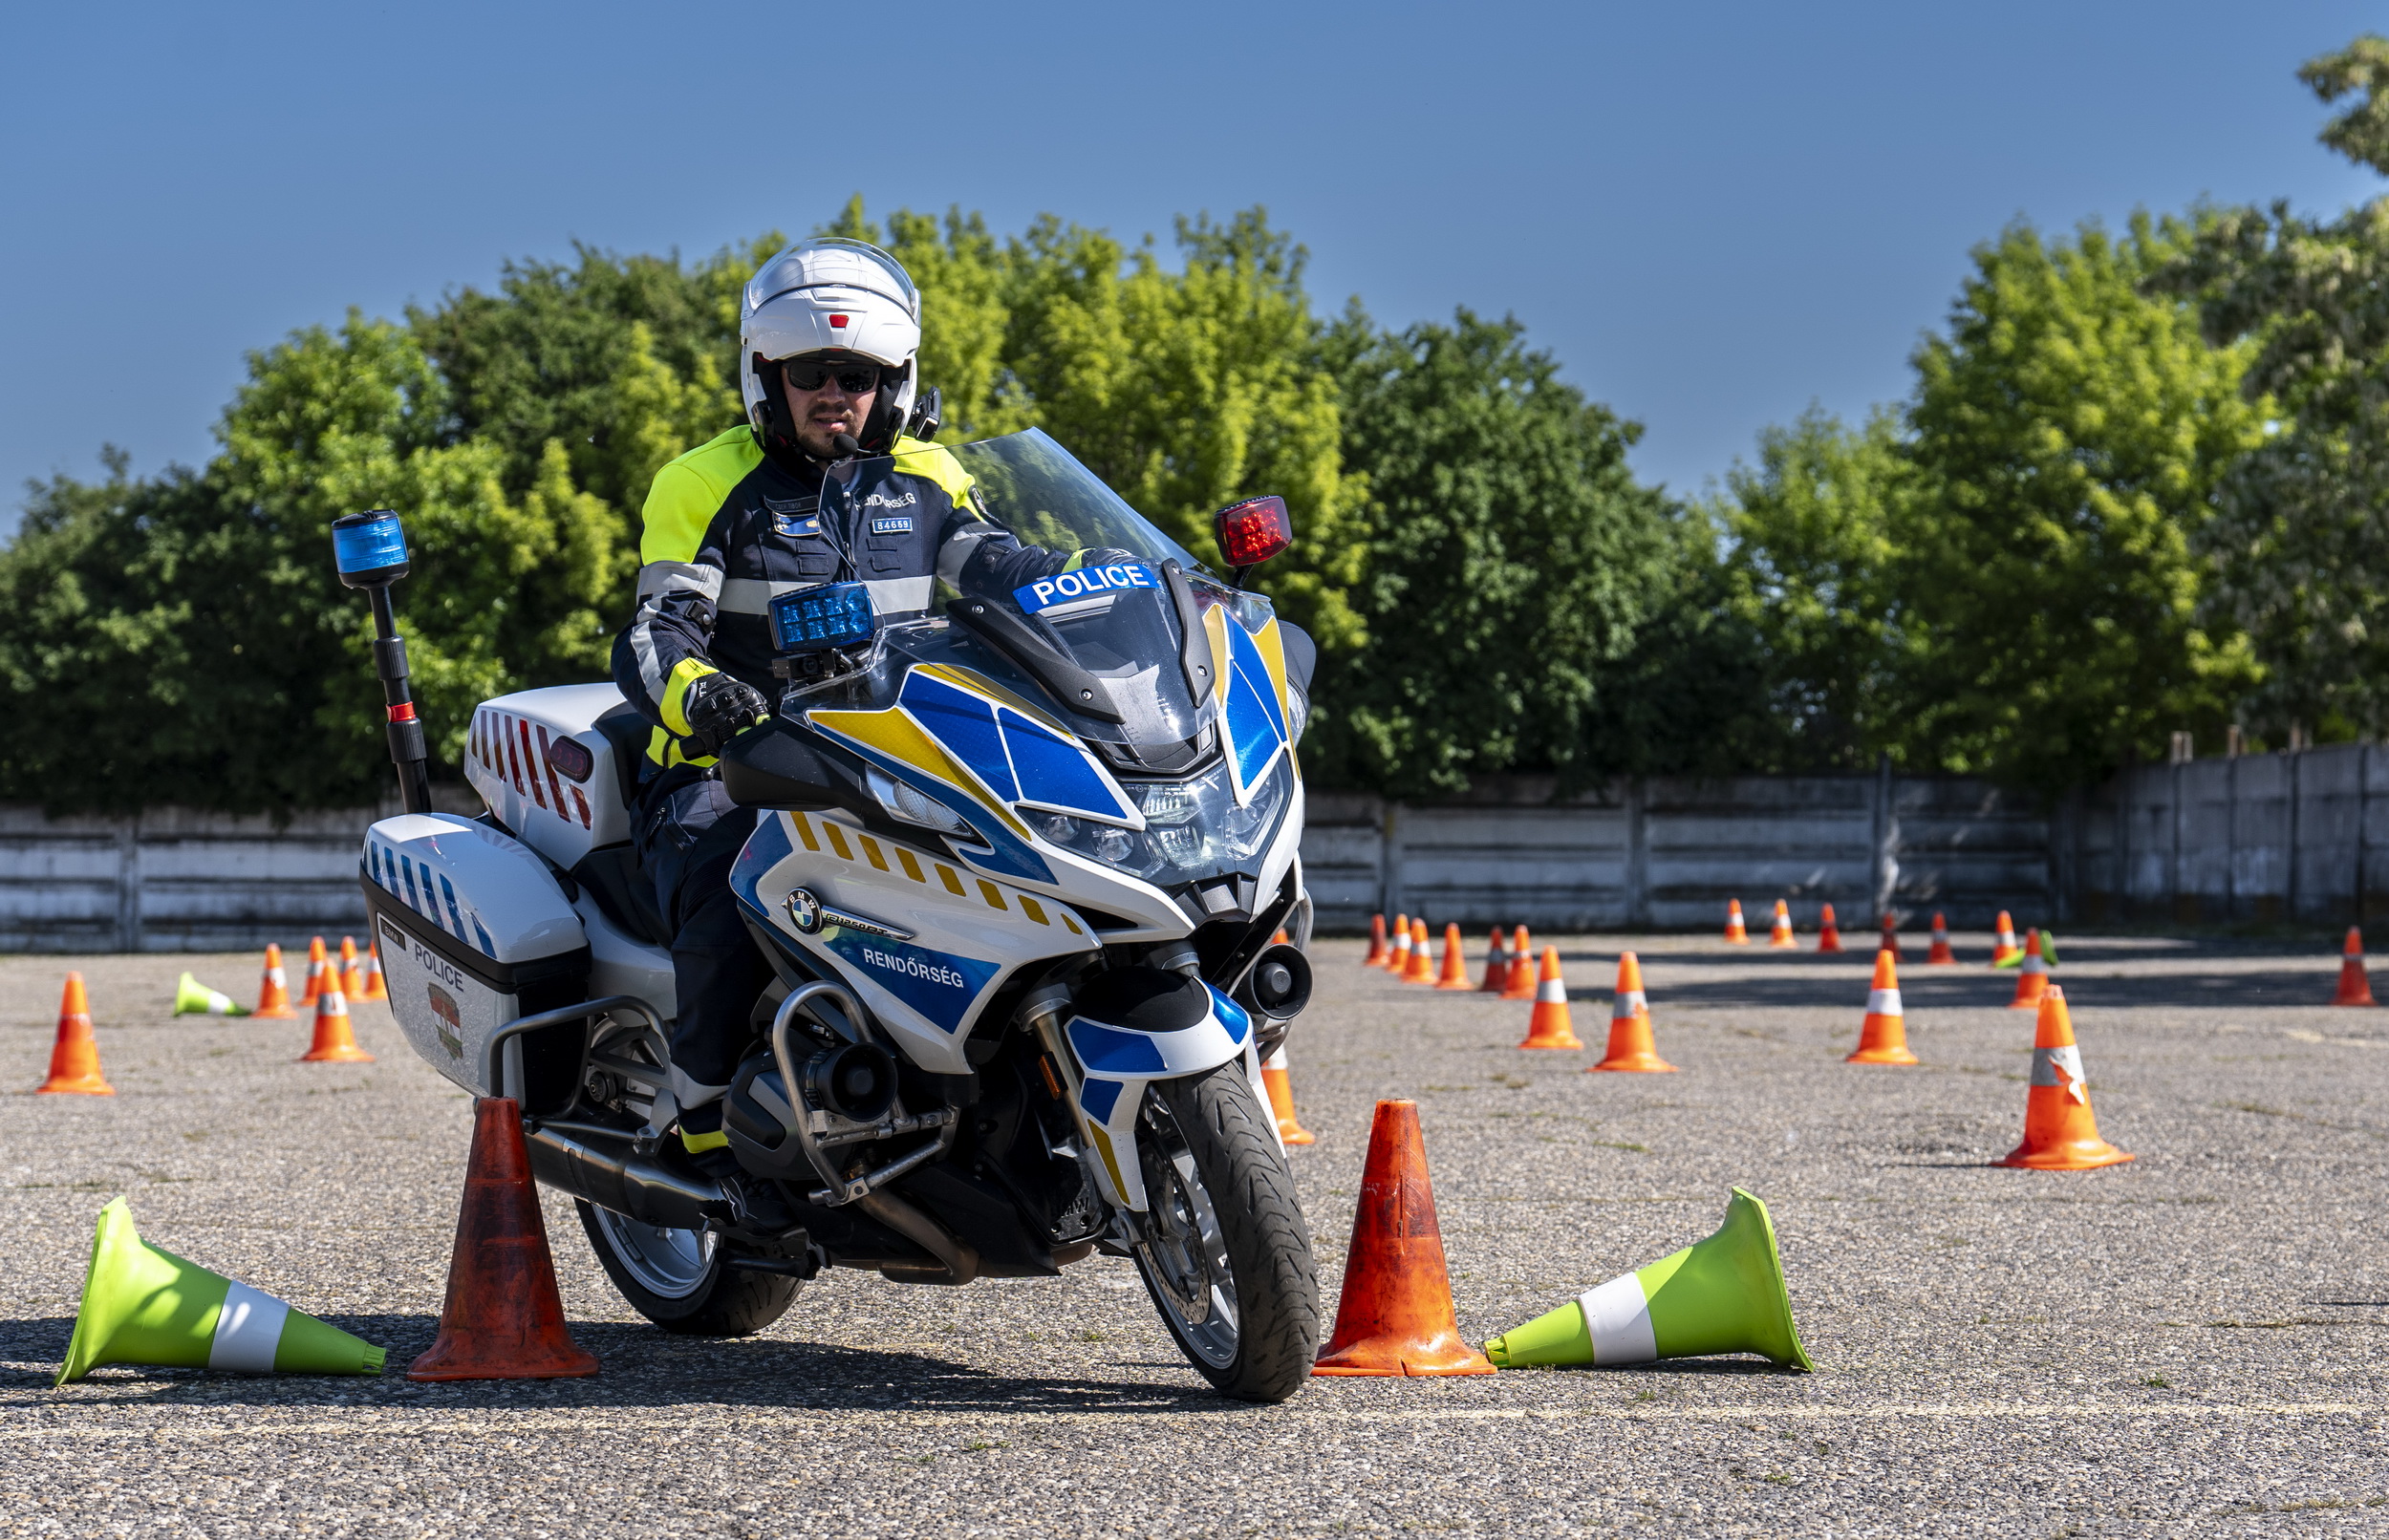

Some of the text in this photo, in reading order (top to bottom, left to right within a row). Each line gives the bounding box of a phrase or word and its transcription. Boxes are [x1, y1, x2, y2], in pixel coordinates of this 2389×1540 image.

[1032, 568, 1148, 605] POLICE
[415, 943, 464, 993] POLICE
[863, 948, 964, 989] RENDŐRSÉG
